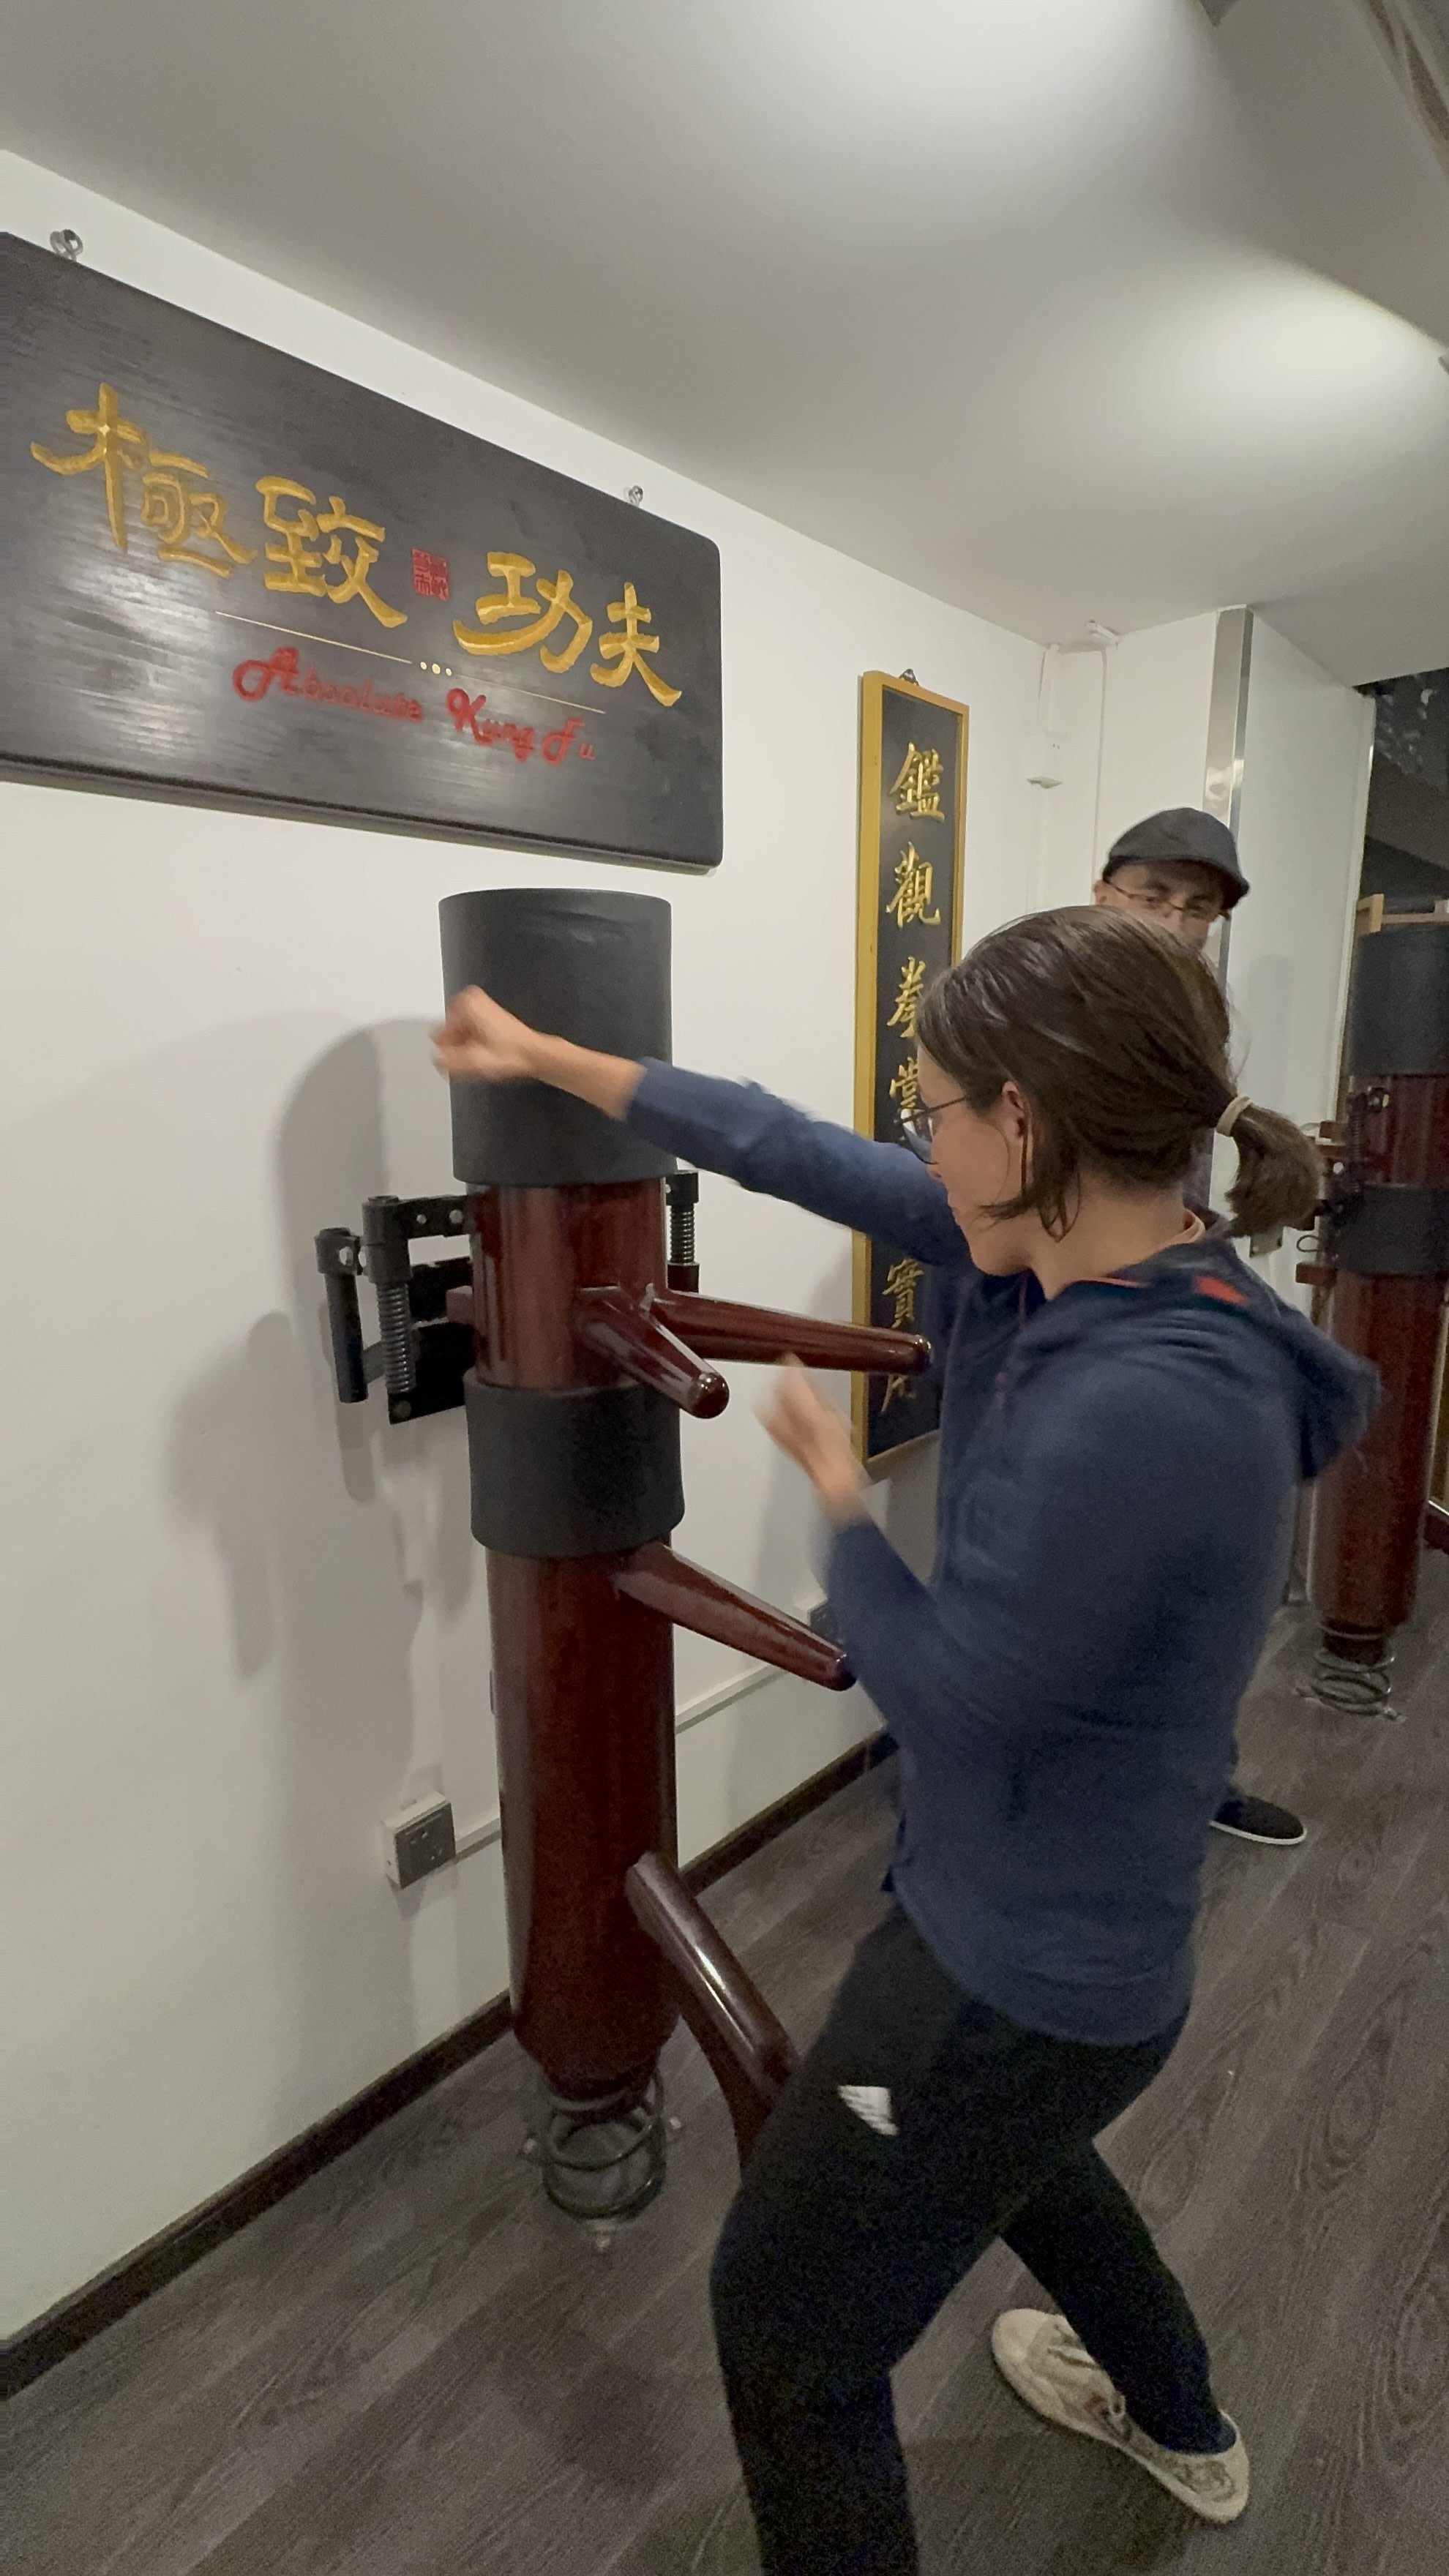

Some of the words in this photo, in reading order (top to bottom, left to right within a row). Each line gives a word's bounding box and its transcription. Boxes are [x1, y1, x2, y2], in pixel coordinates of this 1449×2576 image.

[233, 648, 423, 722] Absolute
[446, 688, 535, 763] Kung
[542, 718, 596, 765] Fu
